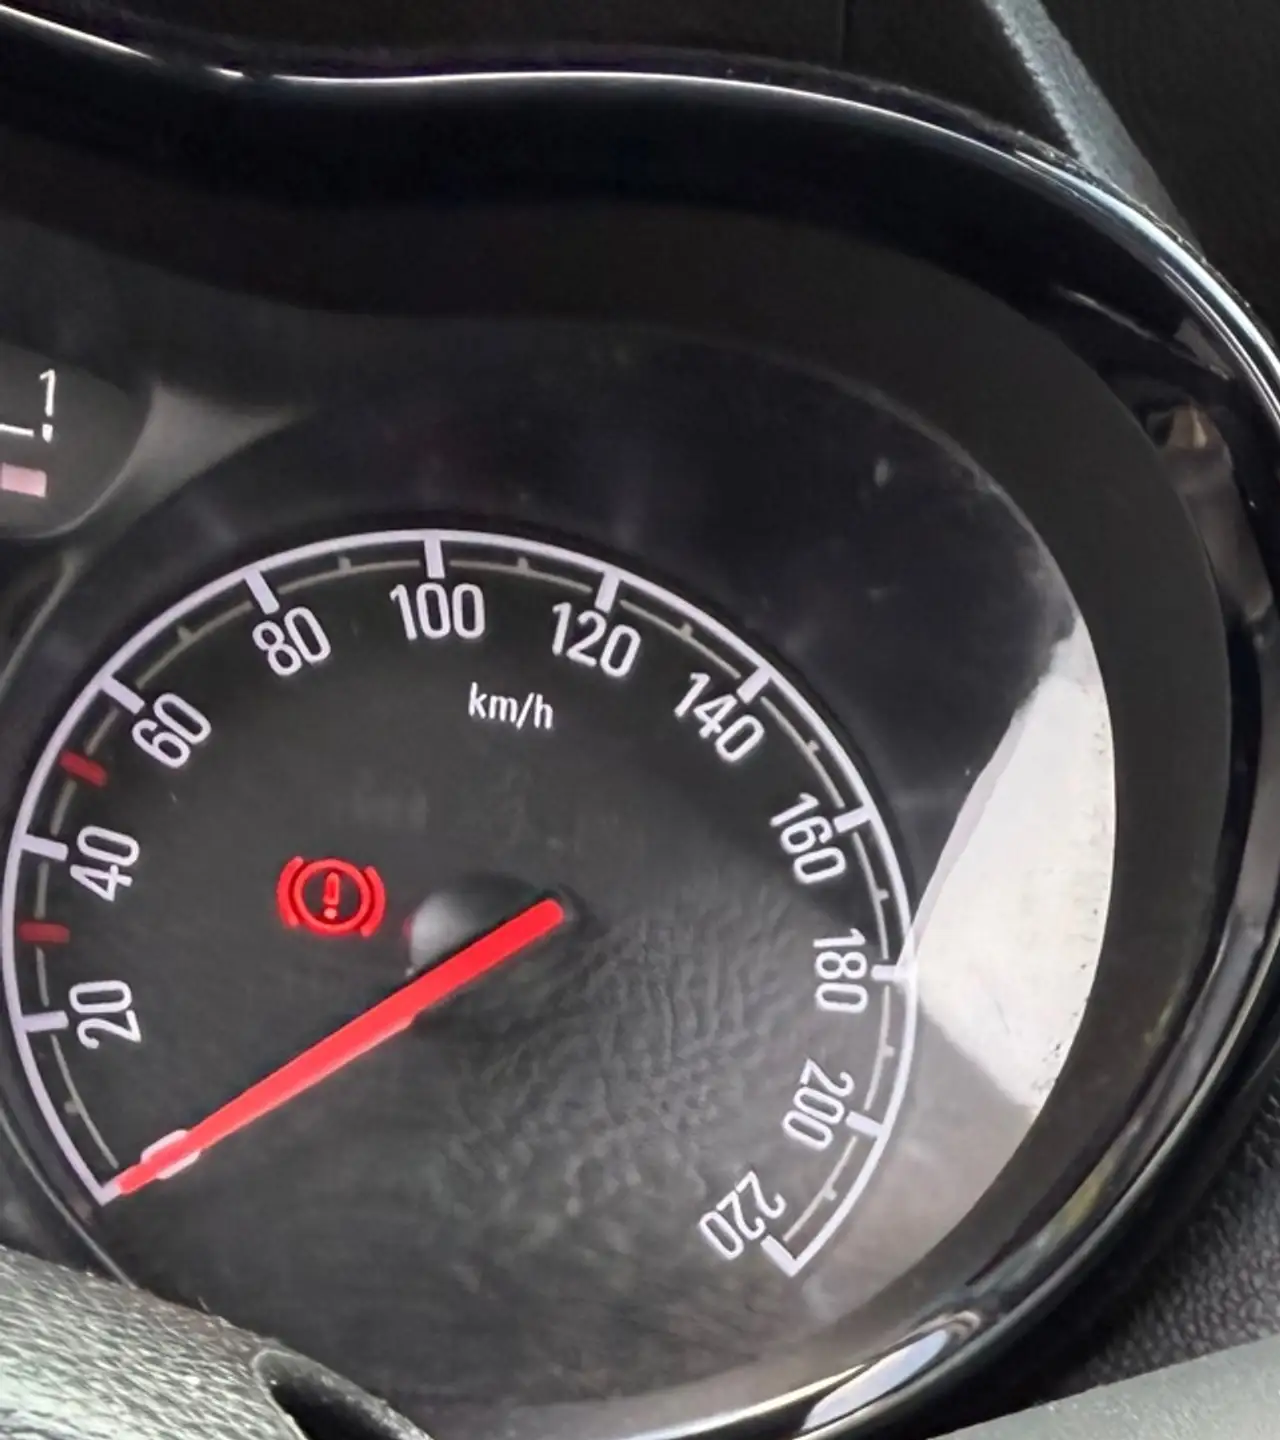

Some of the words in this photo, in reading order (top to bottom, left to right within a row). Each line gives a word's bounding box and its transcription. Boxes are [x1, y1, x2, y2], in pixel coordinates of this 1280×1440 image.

[251, 604, 333, 679] 80
[389, 582, 487, 642] 100
[551, 602, 643, 679] 120
[131, 690, 214, 770] 60
[467, 682, 556, 732] km/h
[672, 671, 767, 764] 140
[67, 824, 142, 903] 40
[768, 791, 849, 886] 160
[811, 928, 870, 1016] 180
[67, 978, 144, 1050] 20
[780, 1056, 857, 1151] 200
[696, 1169, 789, 1263] 220
